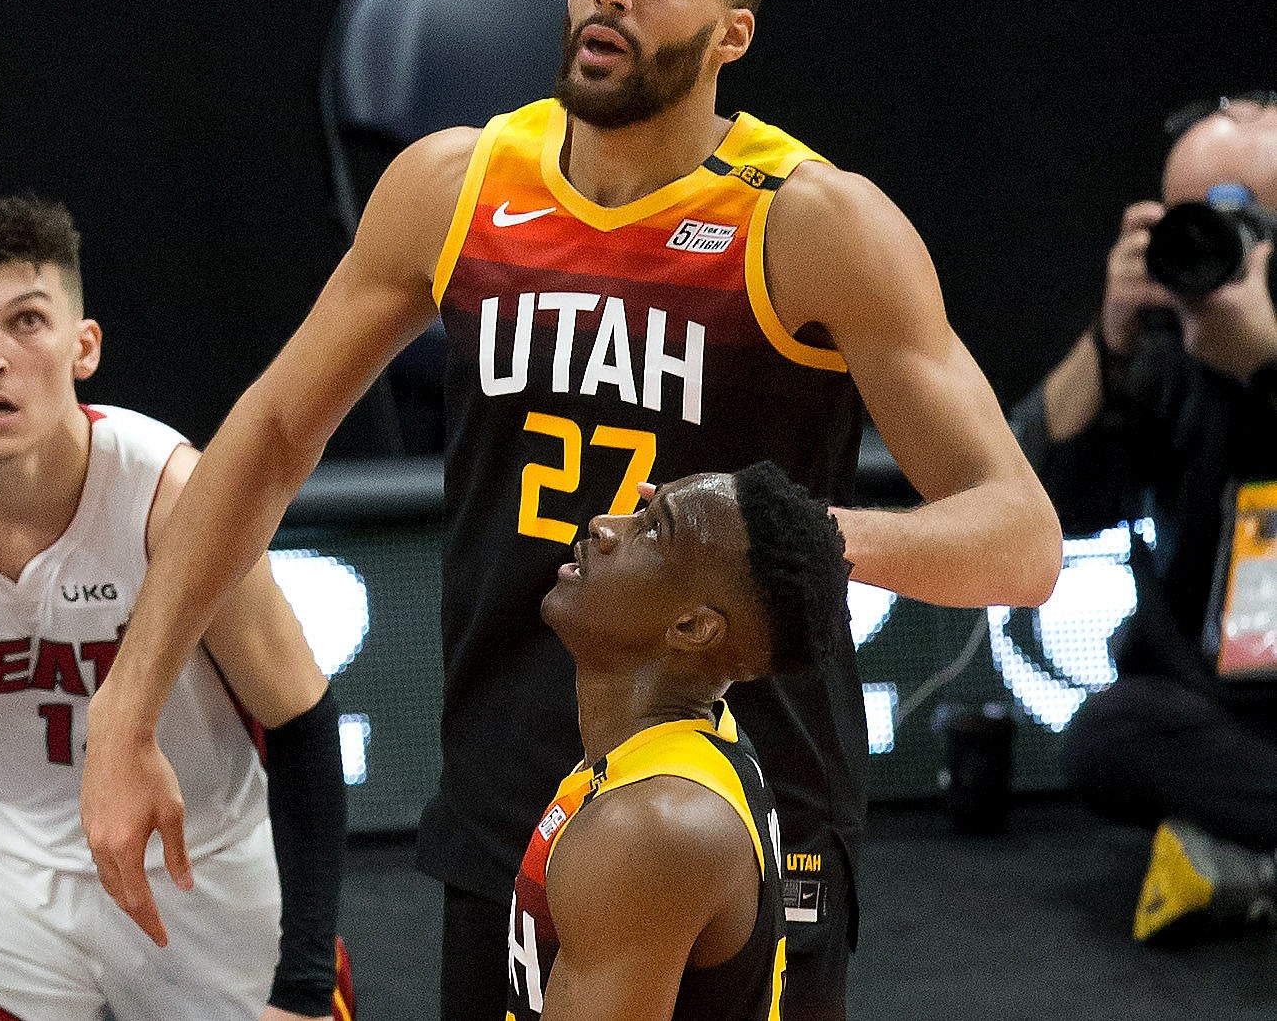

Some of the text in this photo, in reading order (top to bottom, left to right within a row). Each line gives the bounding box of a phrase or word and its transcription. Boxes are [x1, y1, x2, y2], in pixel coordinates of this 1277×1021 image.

[672, 222, 698, 246] 5
[692, 238, 730, 250] FIGHT
[479, 291, 706, 426] UTAH
[517, 411, 657, 546] 27
[60, 583, 118, 603] UKG
[37, 701, 88, 766] 1
[786, 852, 822, 872] UTAH
